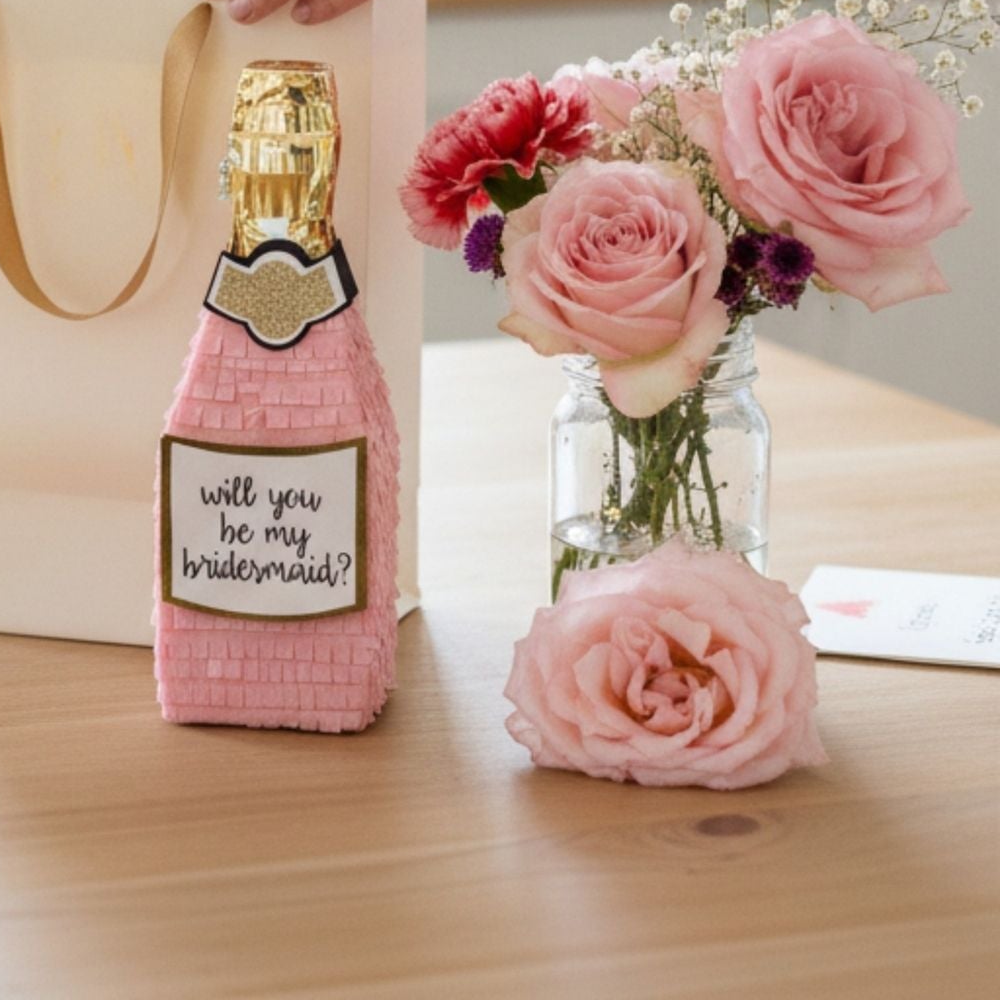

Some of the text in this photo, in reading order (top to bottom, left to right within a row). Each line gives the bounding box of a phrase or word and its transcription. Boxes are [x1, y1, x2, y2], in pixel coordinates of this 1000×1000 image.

[200, 476, 321, 520] will you
[220, 511, 312, 559] be my
[182, 548, 353, 588] bridesmaid?
